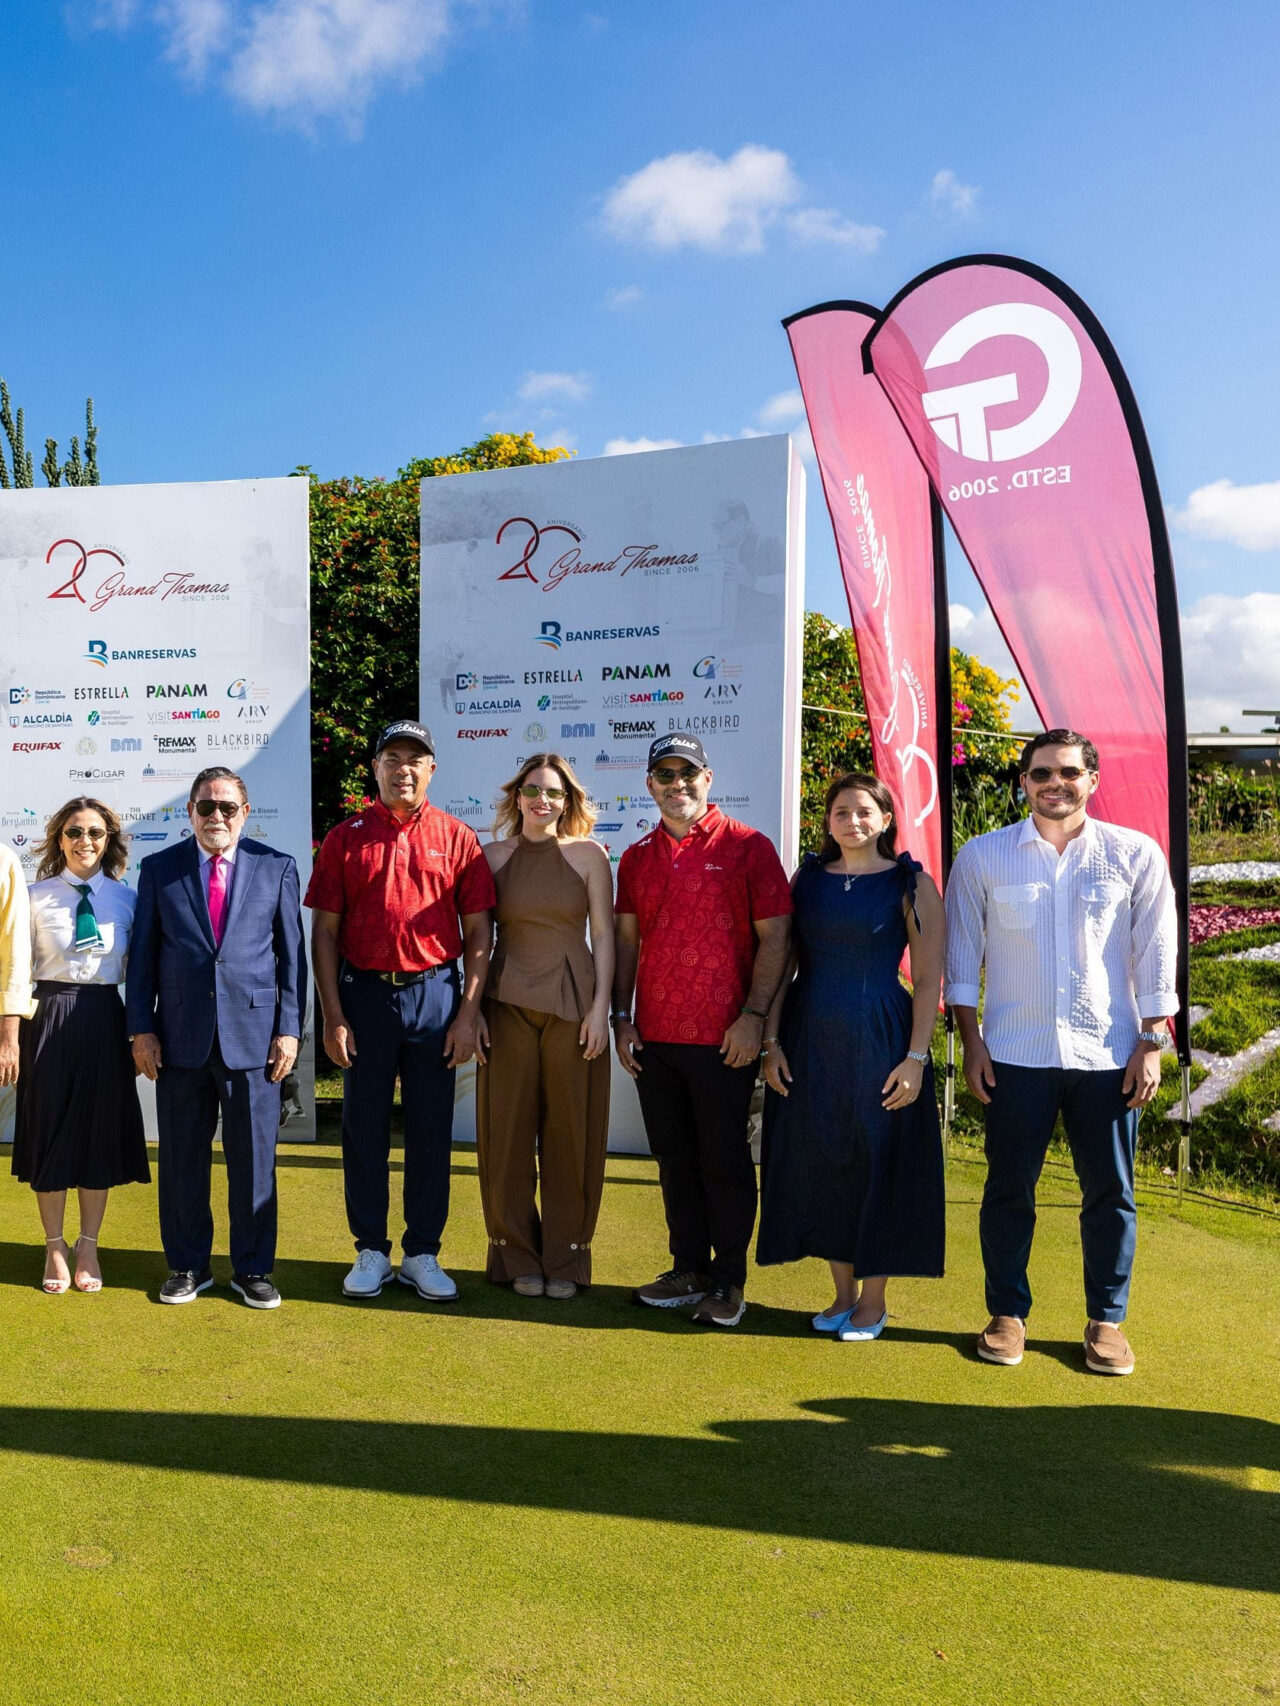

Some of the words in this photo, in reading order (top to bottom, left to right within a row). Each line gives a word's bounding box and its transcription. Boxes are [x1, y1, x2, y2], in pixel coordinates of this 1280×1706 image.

[542, 548, 623, 592] Grand
[621, 544, 699, 577] Thomas
[644, 567, 671, 577] SINCE
[676, 565, 700, 574] 2006
[89, 571, 163, 612] Grand
[161, 572, 230, 601] Thomas
[565, 625, 660, 642] BANRESERVAS
[111, 648, 197, 661] BANRESERVAS
[524, 669, 583, 685] ESTRELLA
[602, 663, 671, 681] PANAM
[74, 686, 129, 700] ESTRELLA
[146, 684, 208, 698] PANAM
[704, 683, 742, 699] ARV
[469, 697, 521, 711] ALCALDÍA
[23, 712, 73, 724] ALCALDÍA
[668, 714, 740, 731] BLACKBIRD
[383, 722, 427, 740] Titleist
[456, 728, 509, 740] EQUIFAX
[613, 731, 657, 740] Monumental
[207, 733, 270, 746] BLACKBIRD
[12, 741, 62, 753] EQUIFAX
[652, 737, 698, 757] Titleist
